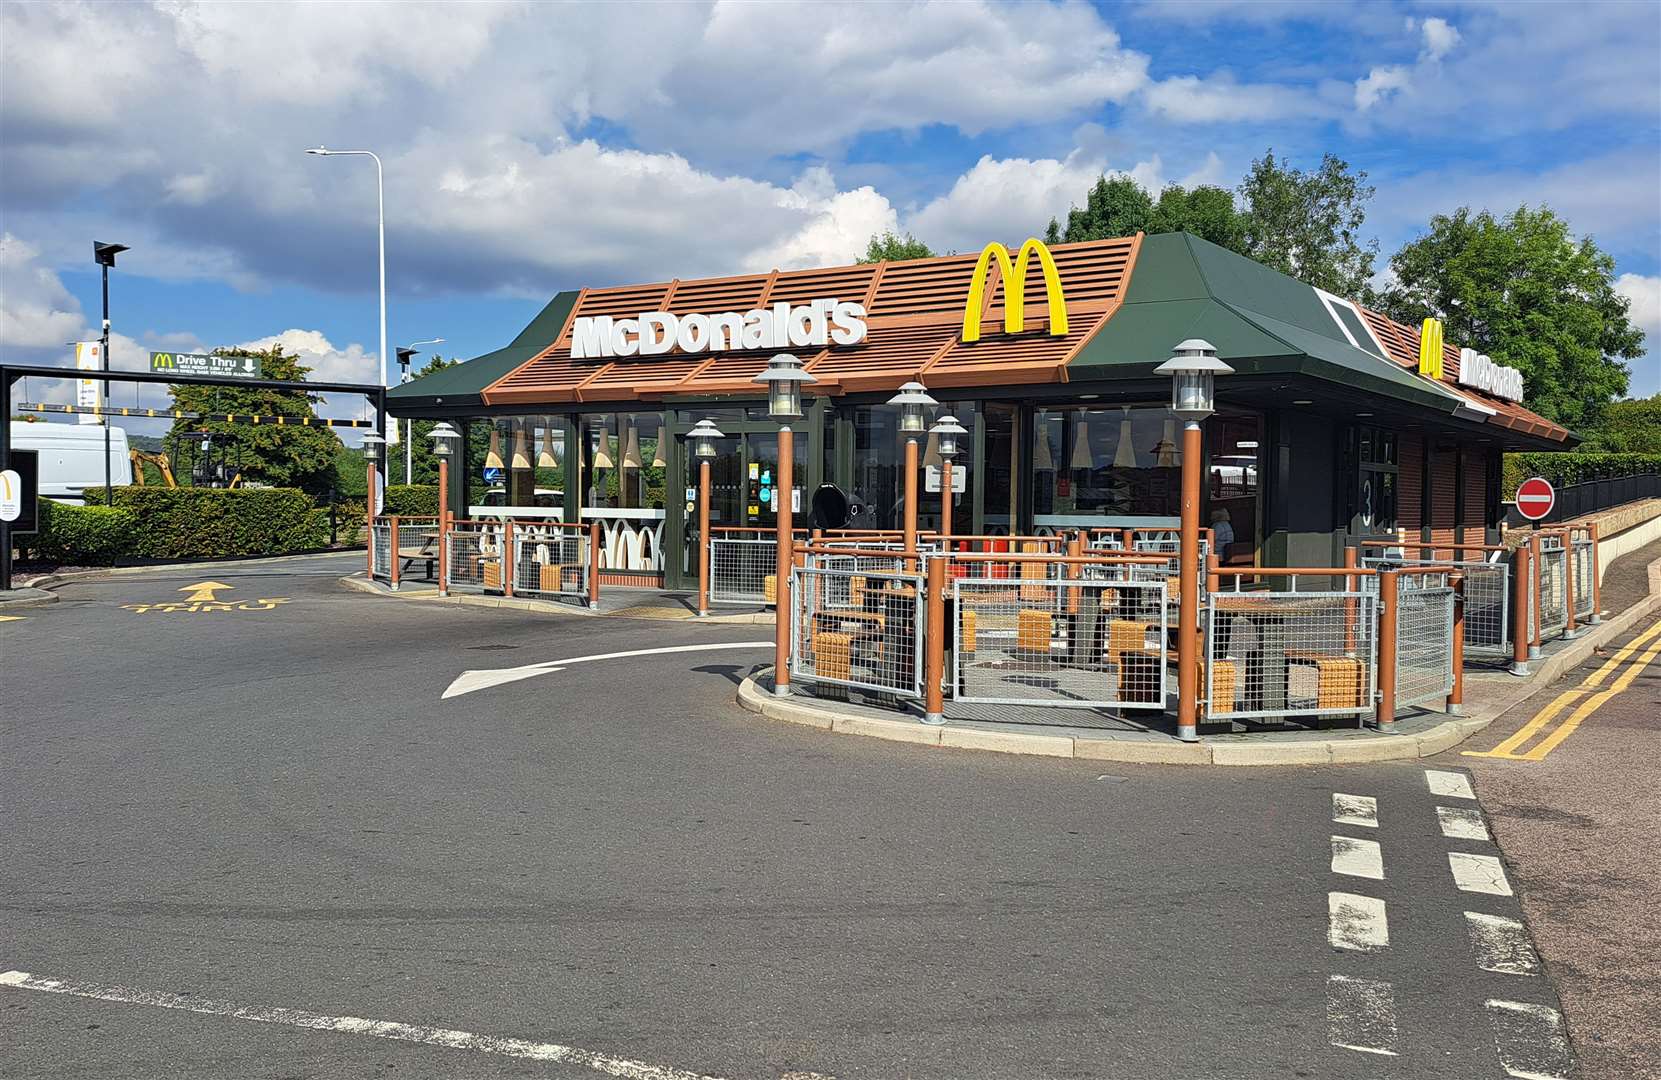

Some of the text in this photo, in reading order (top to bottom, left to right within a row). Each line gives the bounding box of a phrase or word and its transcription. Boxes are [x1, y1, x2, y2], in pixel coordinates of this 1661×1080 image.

[570, 298, 868, 358] McDonald's
[176, 355, 236, 367] Drive Thru
